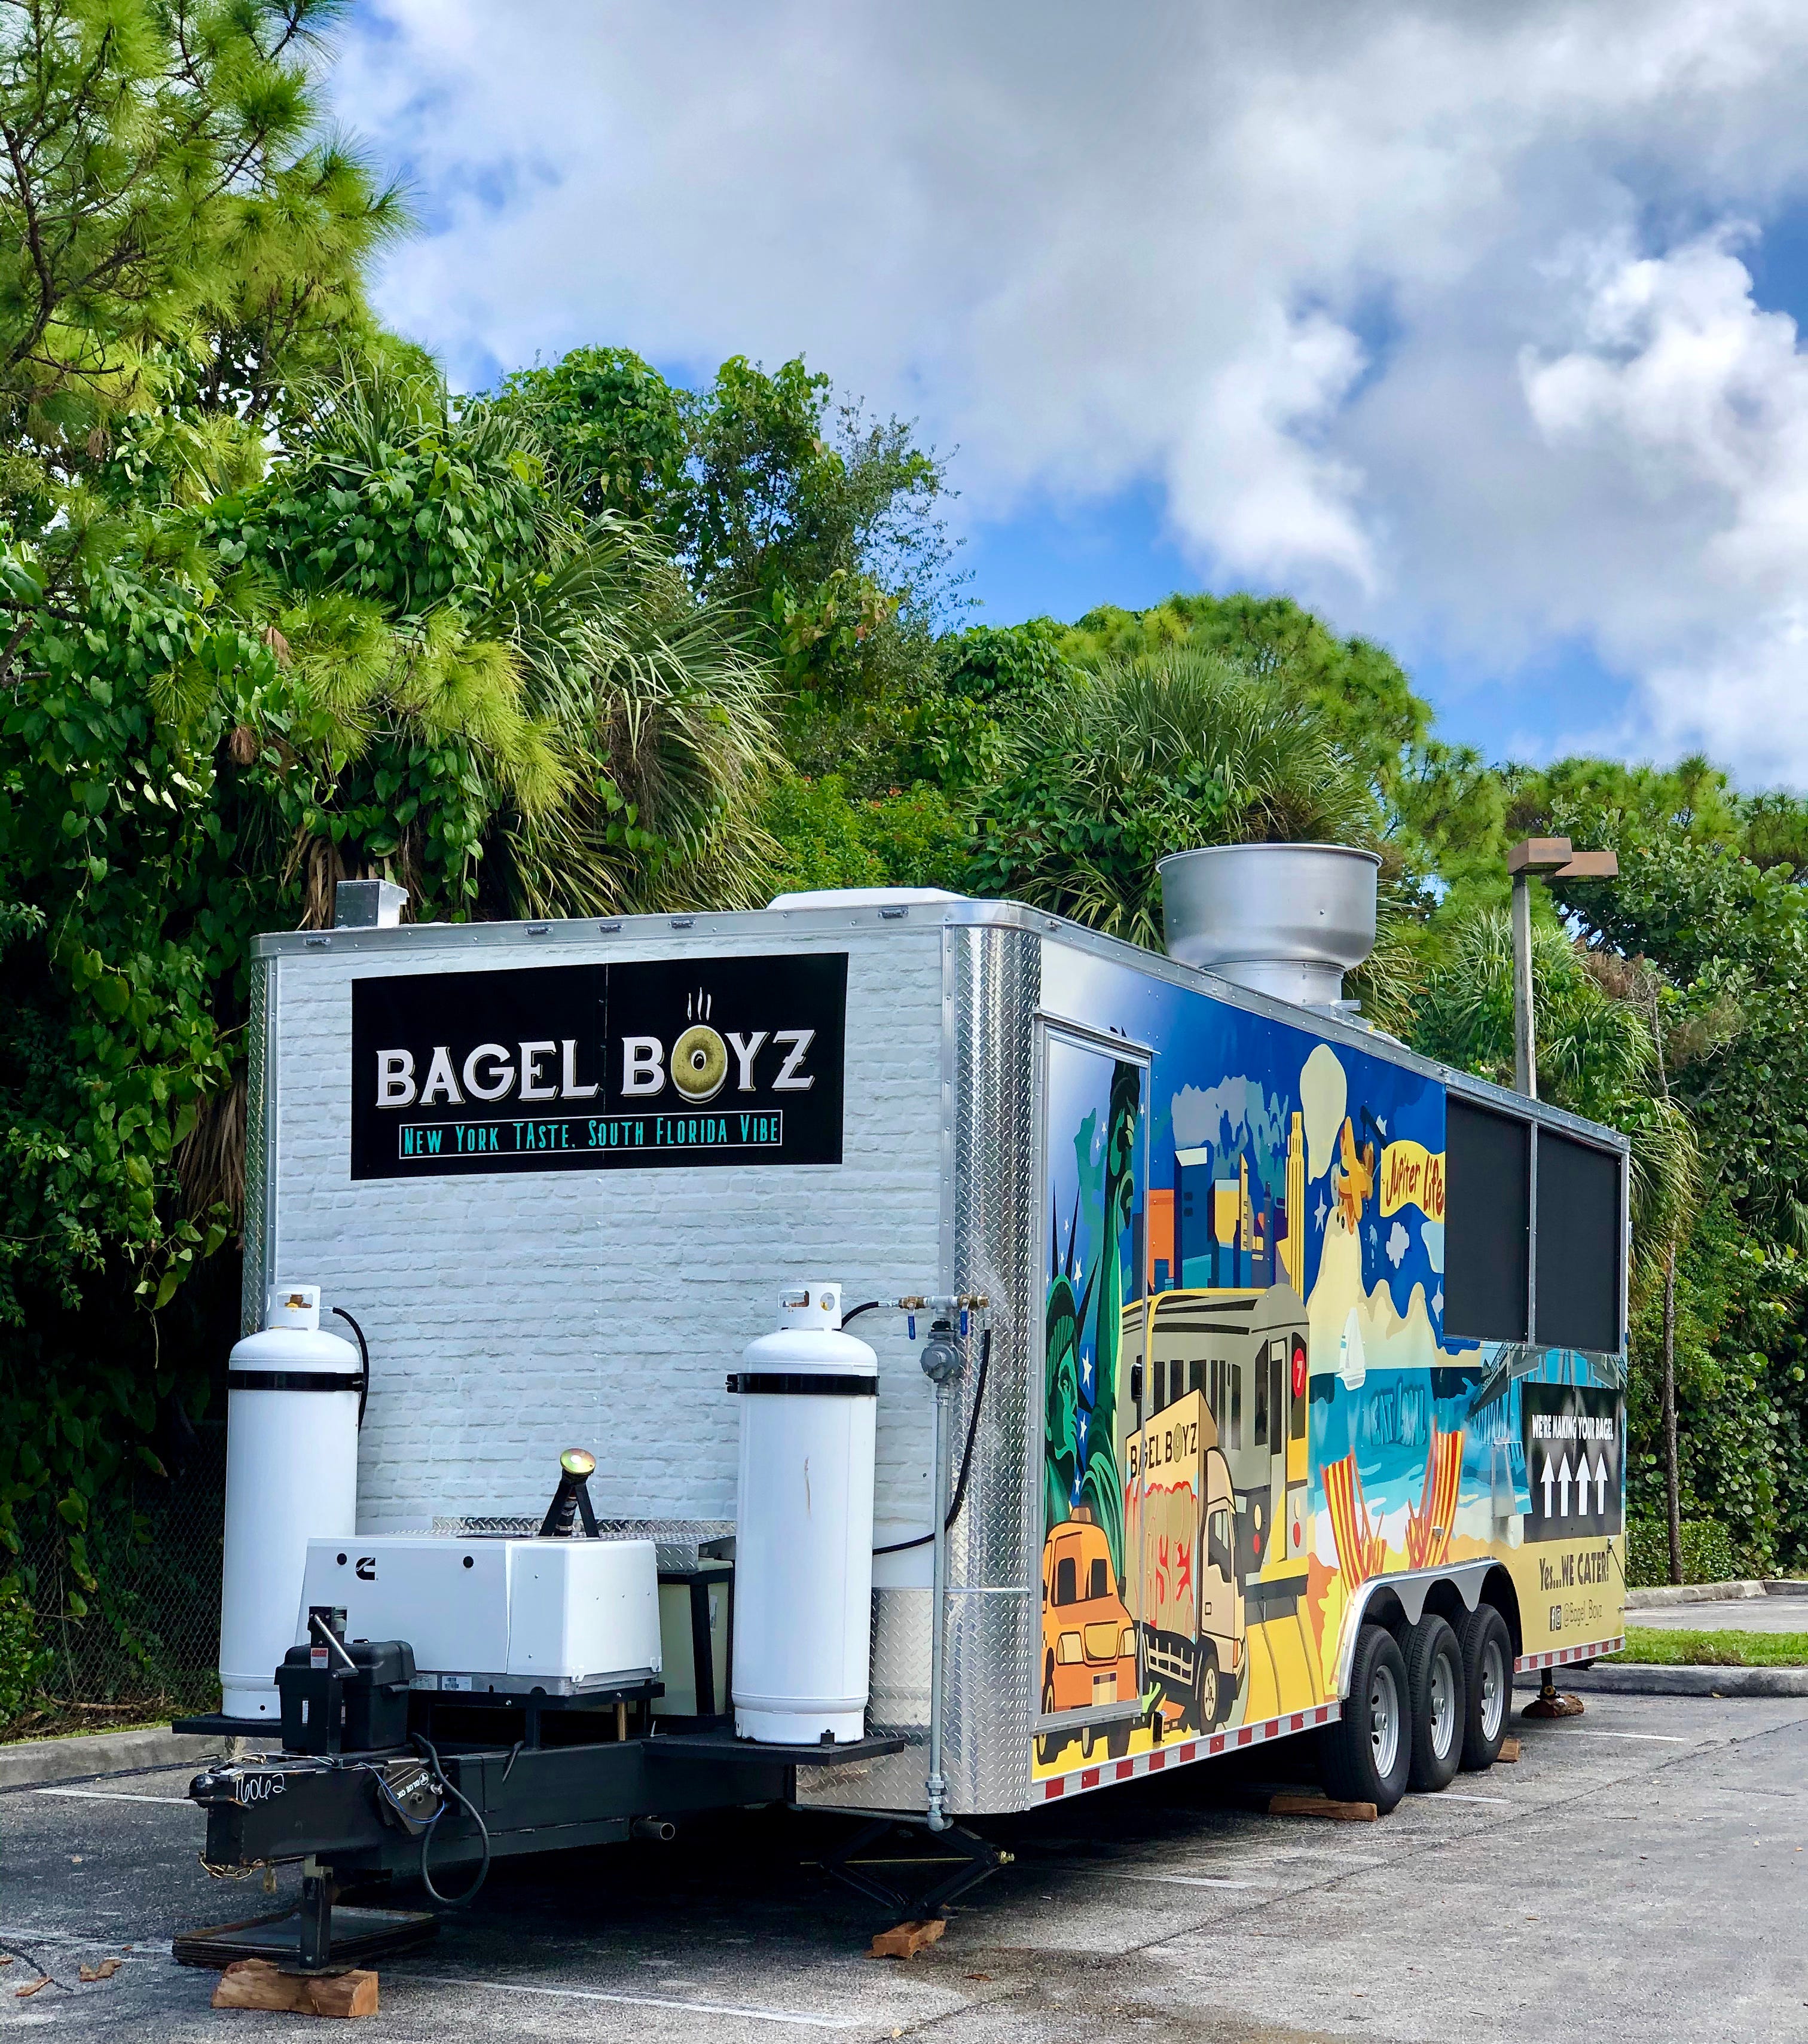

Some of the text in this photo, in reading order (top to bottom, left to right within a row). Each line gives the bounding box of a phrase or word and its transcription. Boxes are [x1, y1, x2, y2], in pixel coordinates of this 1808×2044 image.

[375, 1025, 816, 1108] BAGEL BOYZ
[404, 1114, 778, 1154] NEW YORK TASTE. SOUTH FLORIDA VIBE
[1296, 1360, 1303, 1388] 7
[1165, 1422, 1198, 1464] BOYZ
[1532, 1414, 1614, 1440] WE'RE MAKING YOUR BAGEL
[1577, 1551, 1610, 1585] CATER!
[236, 1773, 287, 1803] 16062
